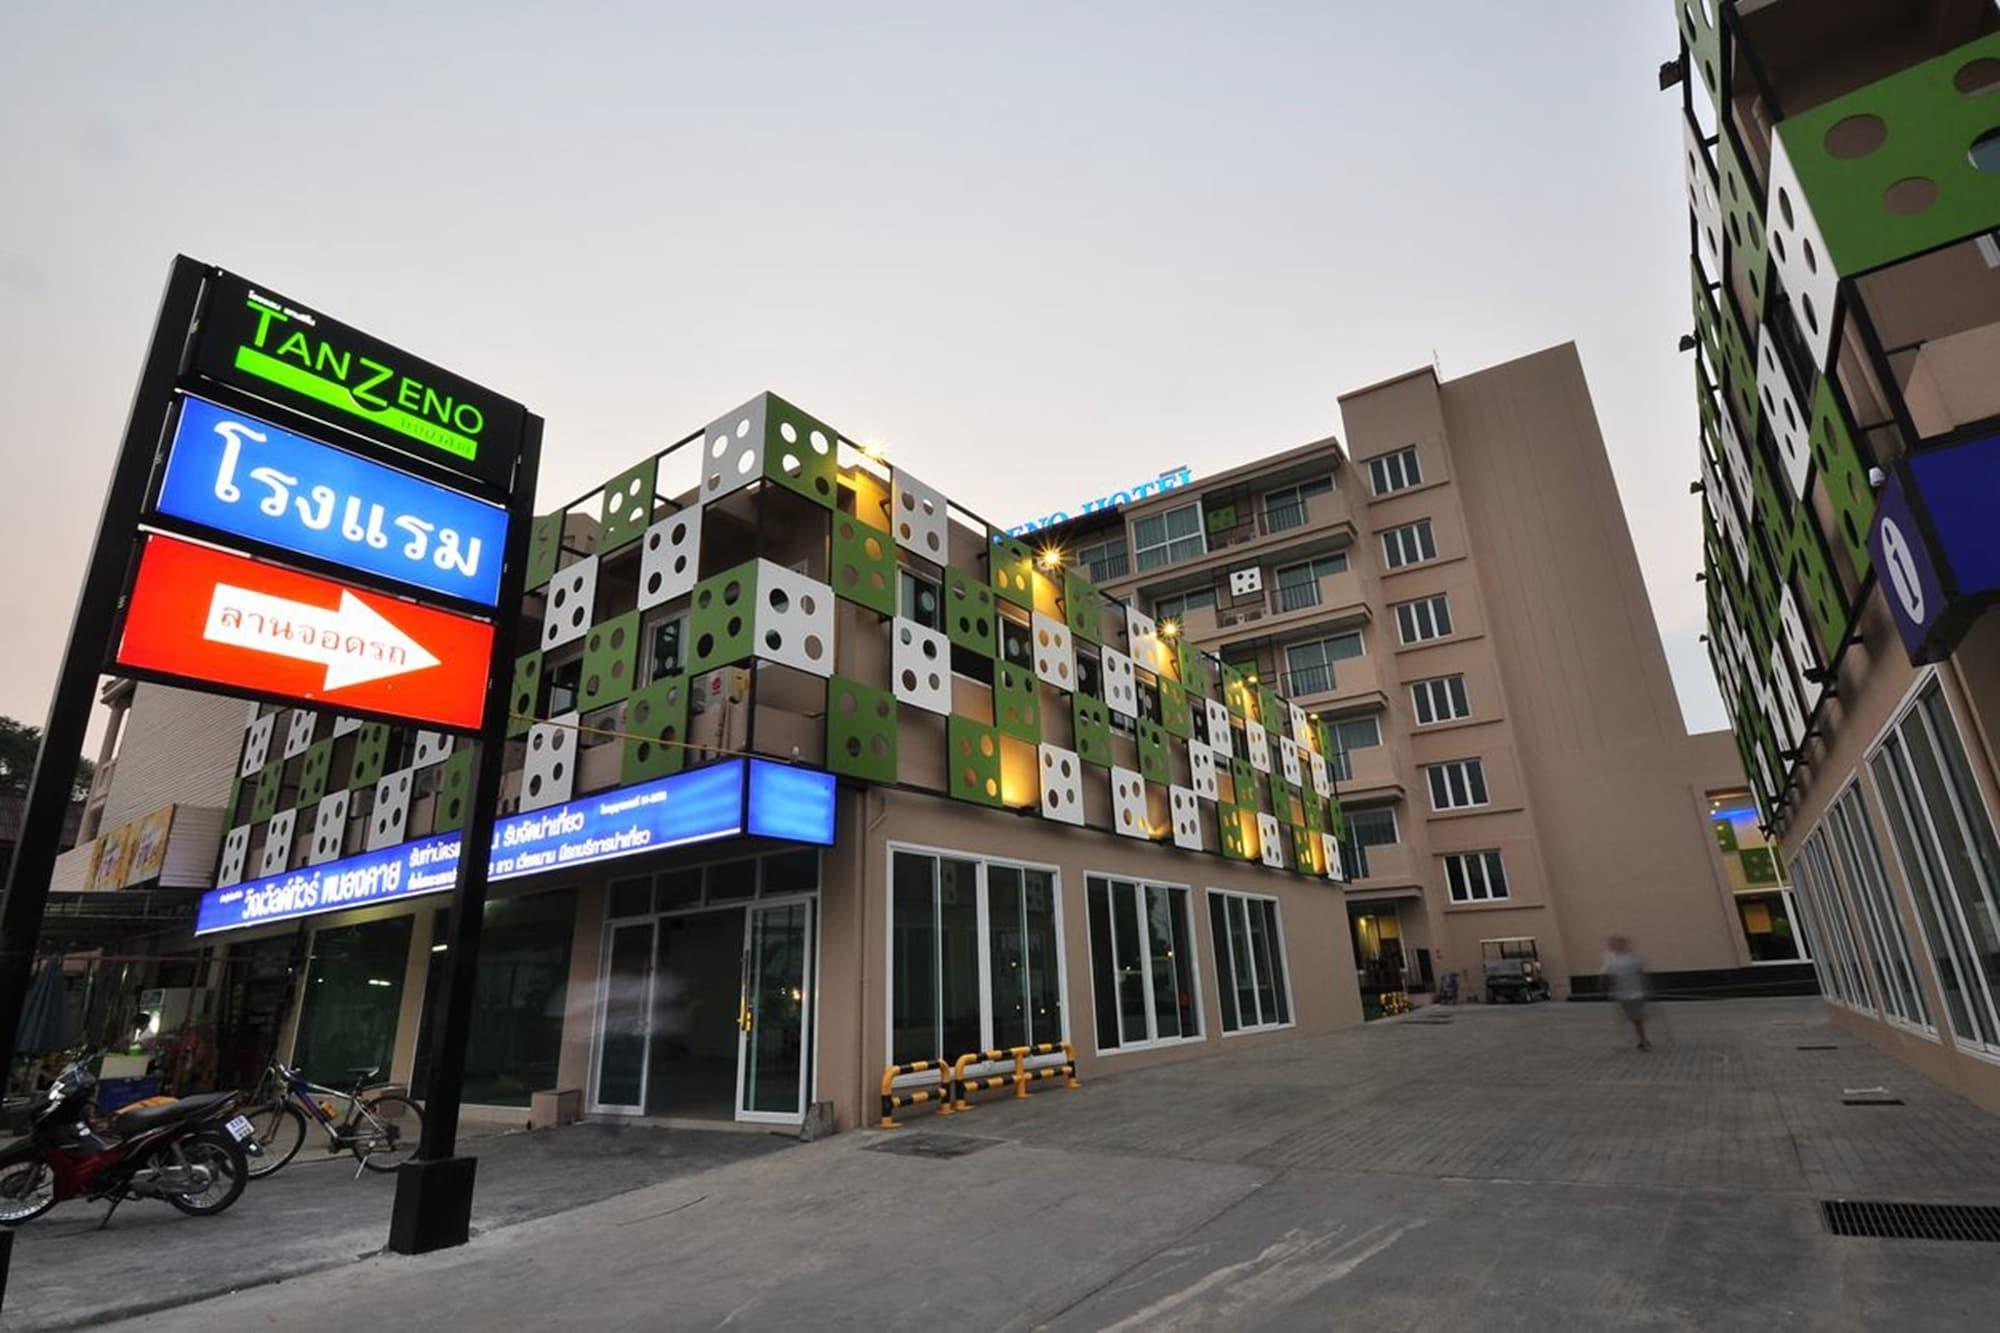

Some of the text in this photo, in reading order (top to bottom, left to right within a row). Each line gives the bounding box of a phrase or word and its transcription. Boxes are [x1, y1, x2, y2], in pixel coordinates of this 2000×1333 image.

[245, 300, 484, 434] TANZENO
[213, 420, 482, 577] โรงแรม
[219, 604, 408, 667] ลานจอดรถ
